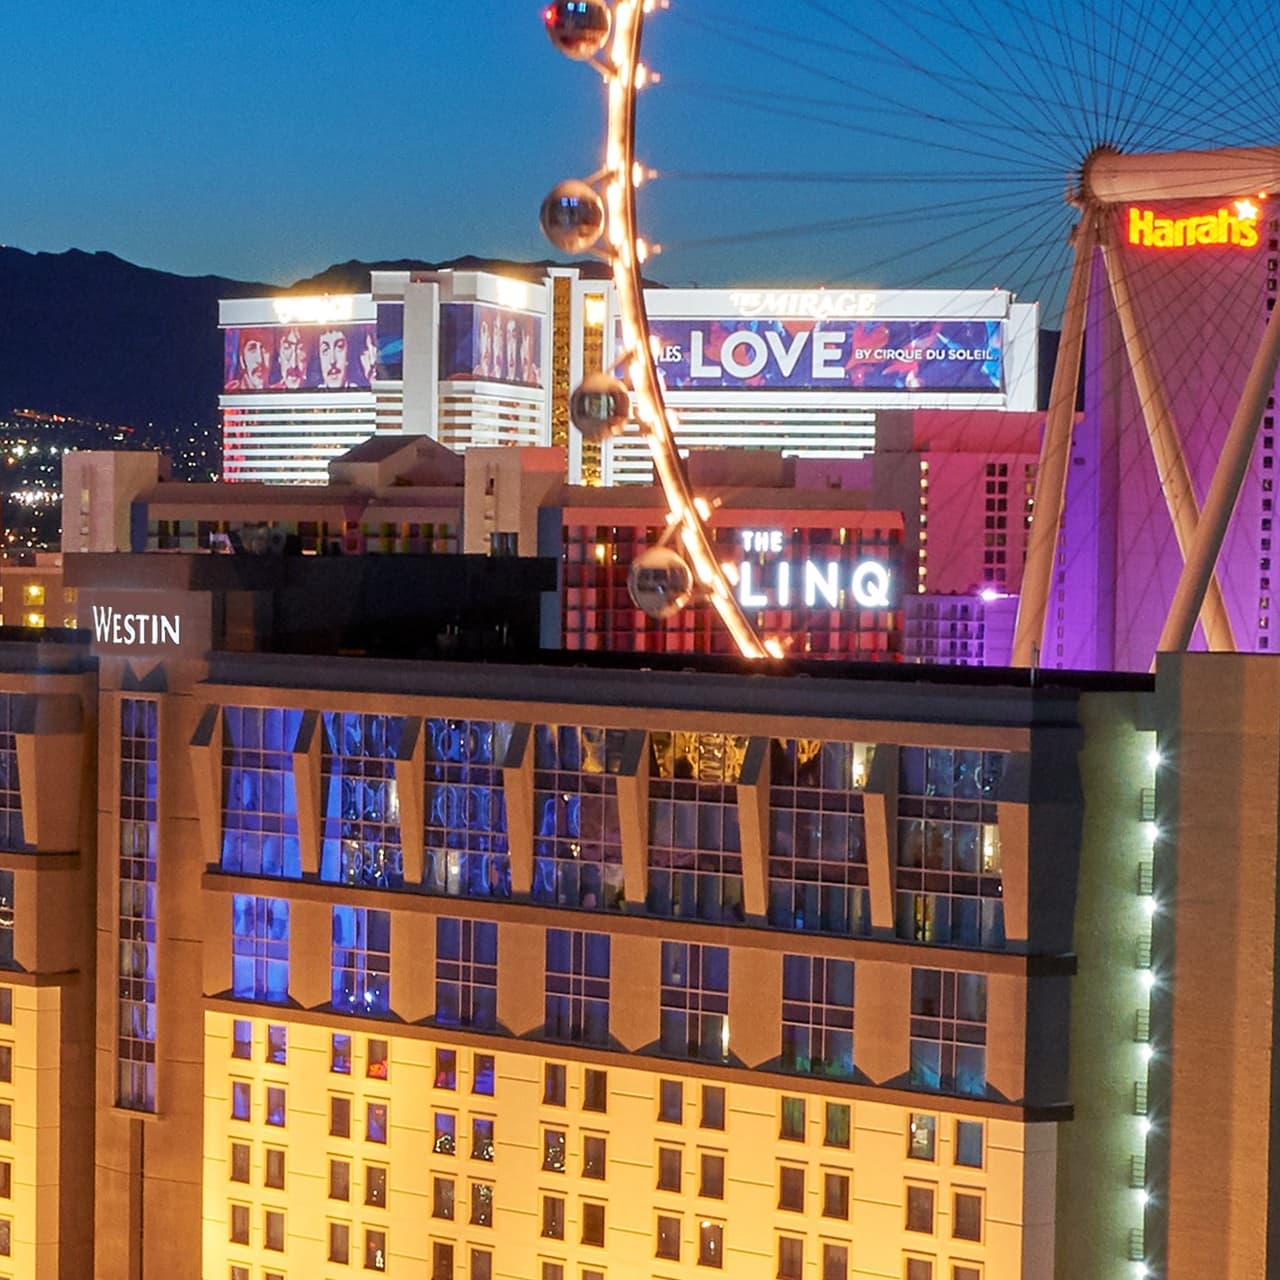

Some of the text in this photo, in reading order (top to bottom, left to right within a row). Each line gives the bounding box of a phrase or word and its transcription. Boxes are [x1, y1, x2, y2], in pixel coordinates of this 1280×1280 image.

[738, 292, 877, 318] MIRAGE
[690, 330, 846, 379] LOVE
[855, 348, 871, 360] BY
[874, 348, 922, 363] CIRQUE
[926, 348, 945, 360] DU
[948, 348, 993, 360] SOLEIL
[742, 530, 783, 552] THE
[740, 559, 889, 608] LINQ
[92, 605, 180, 645] WESTIN
